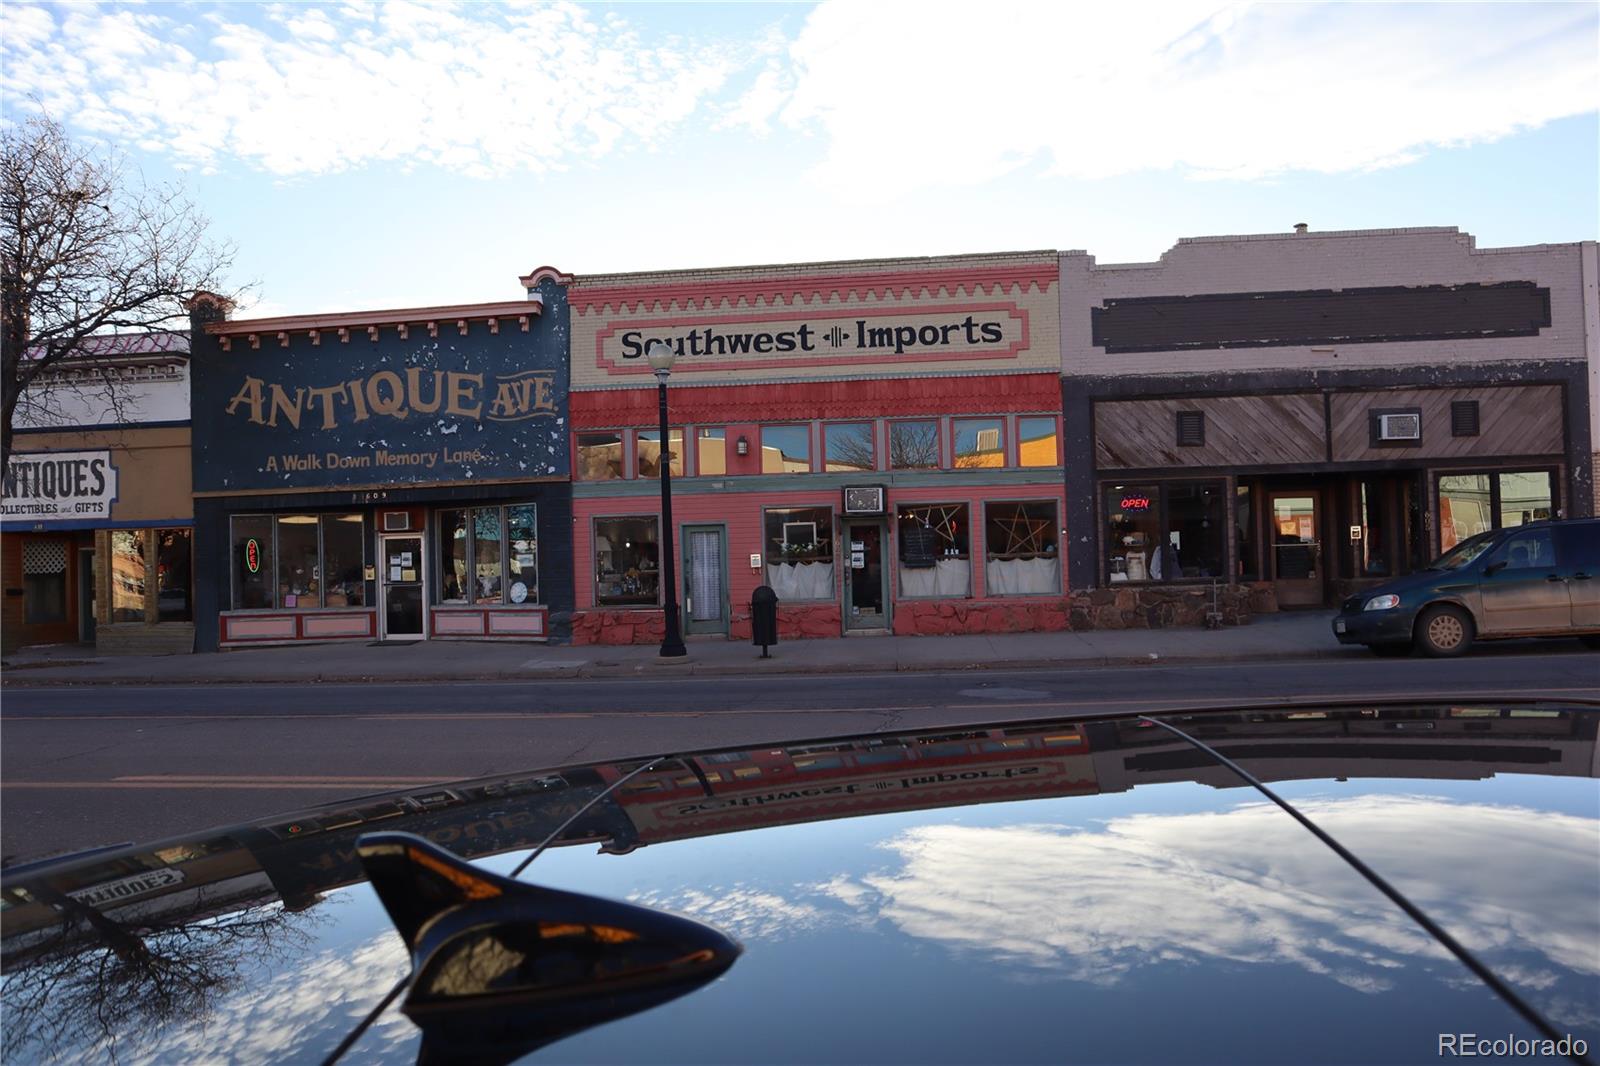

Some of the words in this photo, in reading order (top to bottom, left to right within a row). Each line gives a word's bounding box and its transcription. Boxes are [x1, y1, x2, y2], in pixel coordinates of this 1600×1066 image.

[621, 323, 815, 359] Southwest
[855, 315, 1003, 354] Imports
[225, 367, 484, 430] ANTIQUE
[265, 455, 279, 473] A
[282, 453, 322, 471] Walk
[326, 452, 370, 469] Down
[375, 449, 438, 468] Memory
[74, 502, 104, 513] GIFTS
[1121, 499, 1149, 509] OPEN
[249, 541, 257, 570] OPEN
